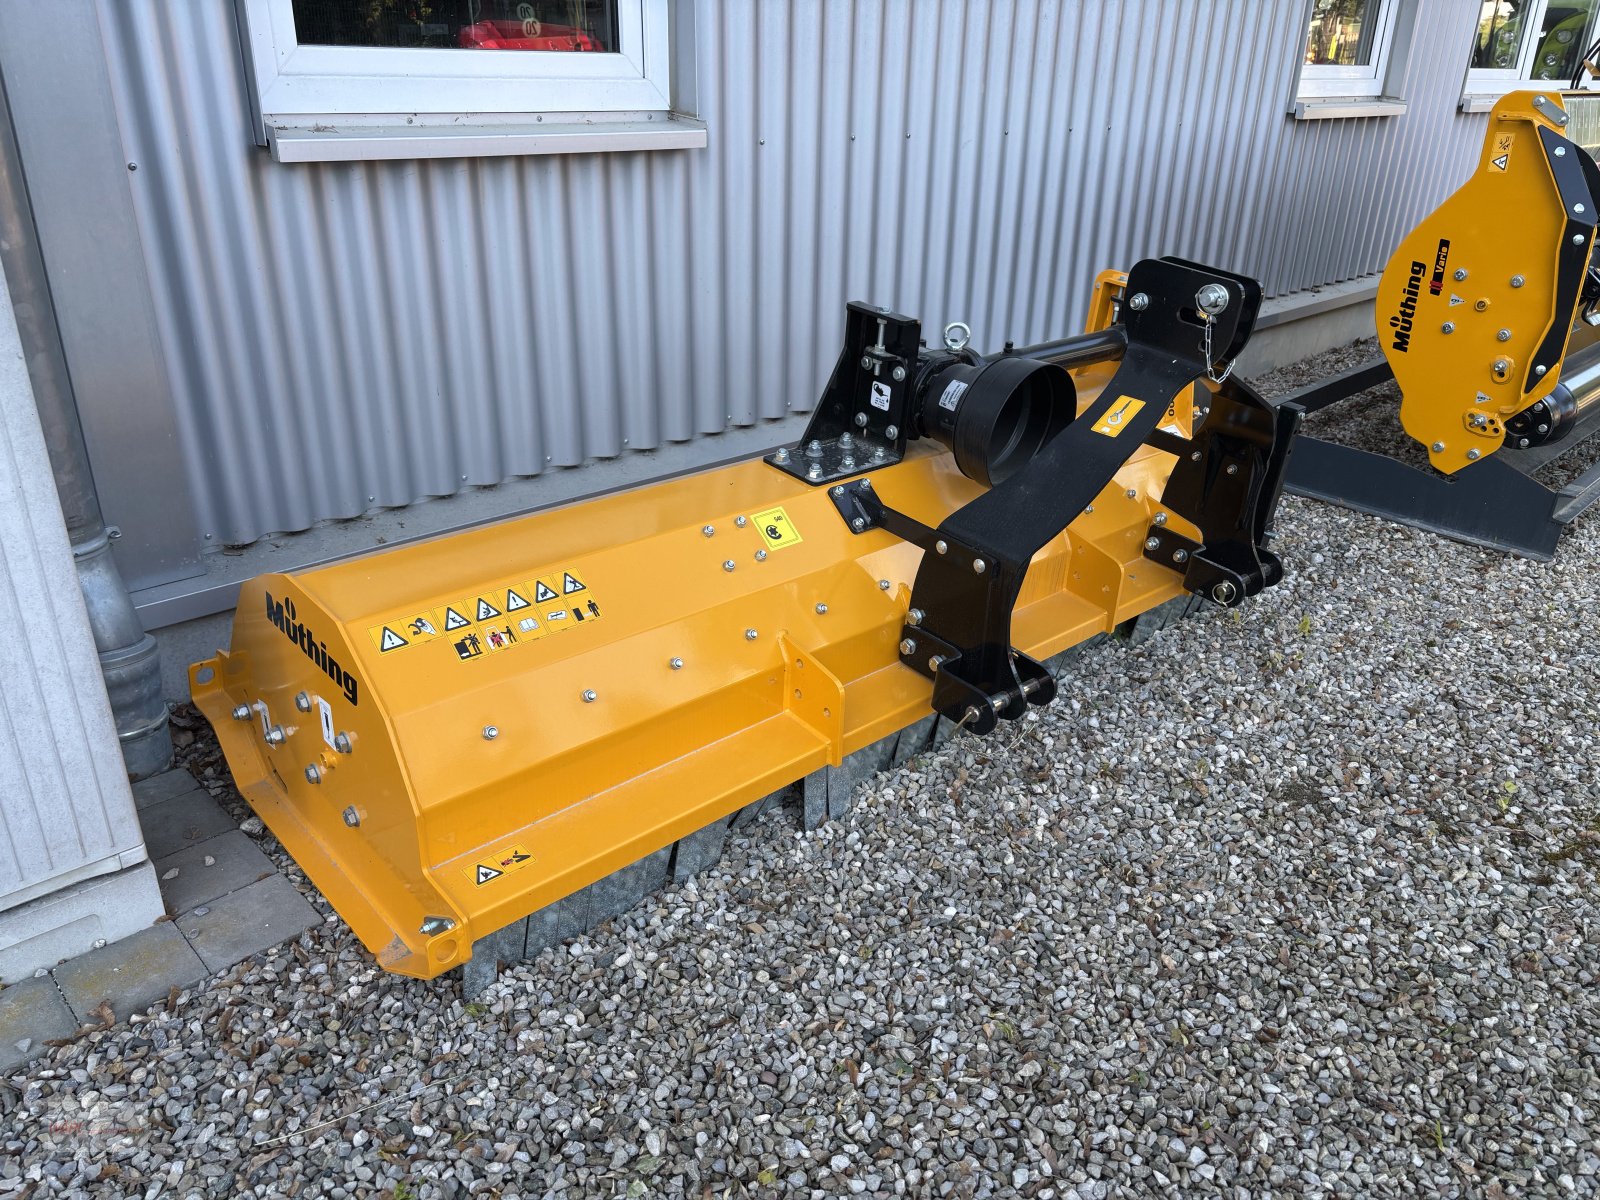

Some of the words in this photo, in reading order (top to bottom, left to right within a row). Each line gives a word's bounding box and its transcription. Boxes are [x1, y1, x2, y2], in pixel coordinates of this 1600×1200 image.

[1435, 246, 1448, 273] Vario
[1390, 260, 1427, 353] Müthing
[265, 590, 358, 707] Müthing
